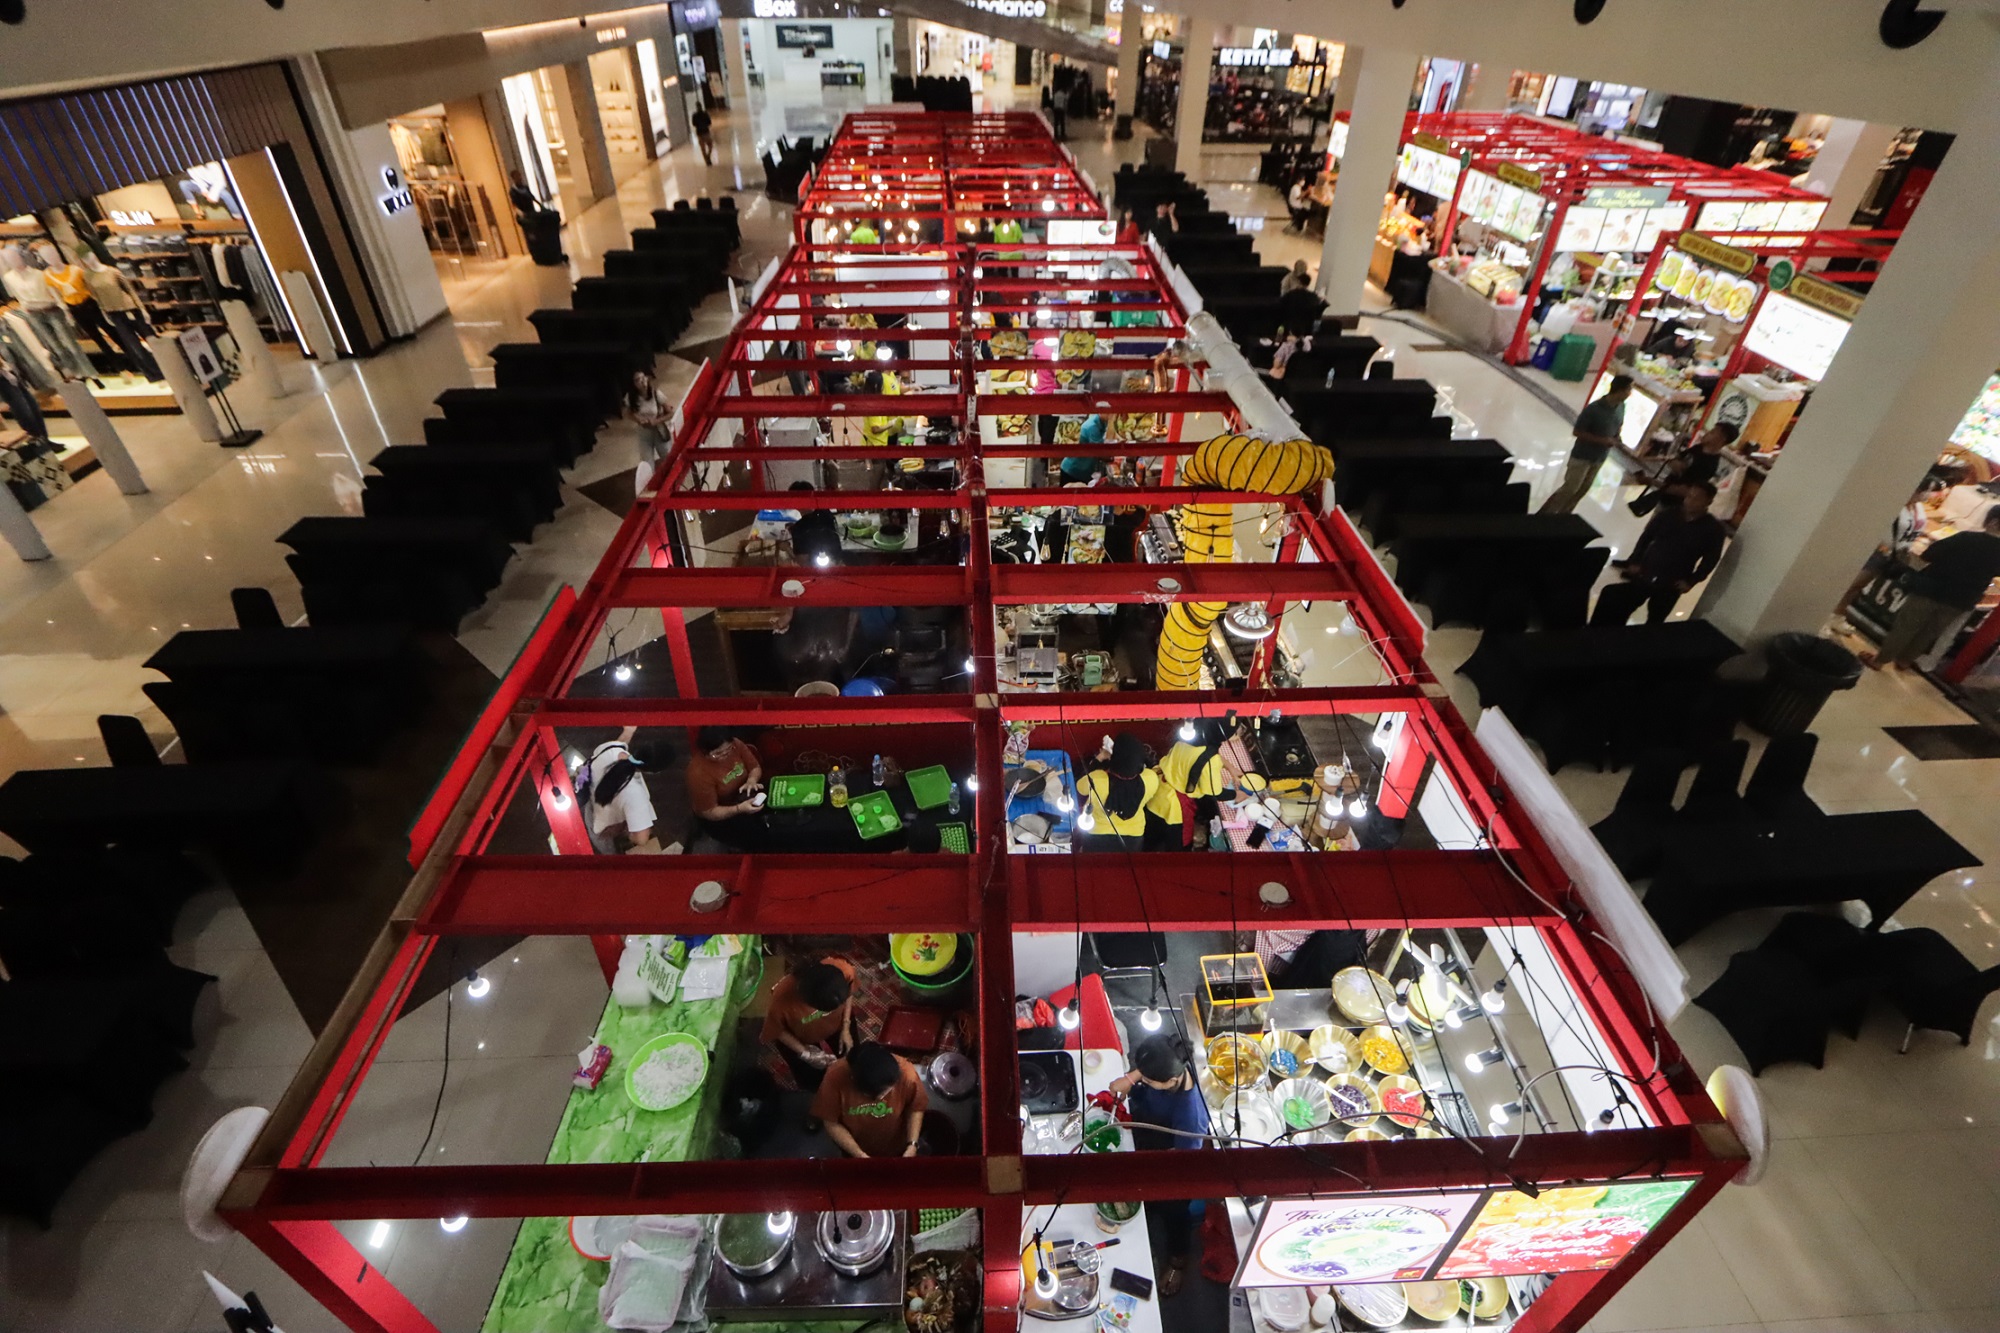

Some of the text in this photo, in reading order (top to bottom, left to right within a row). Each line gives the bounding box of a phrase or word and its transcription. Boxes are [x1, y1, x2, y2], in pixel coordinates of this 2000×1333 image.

[1219, 48, 1293, 66] KETTLER
[110, 210, 155, 226] SLIM
[1285, 1209, 1335, 1221] Thai
[1339, 1208, 1384, 1220] Lod
